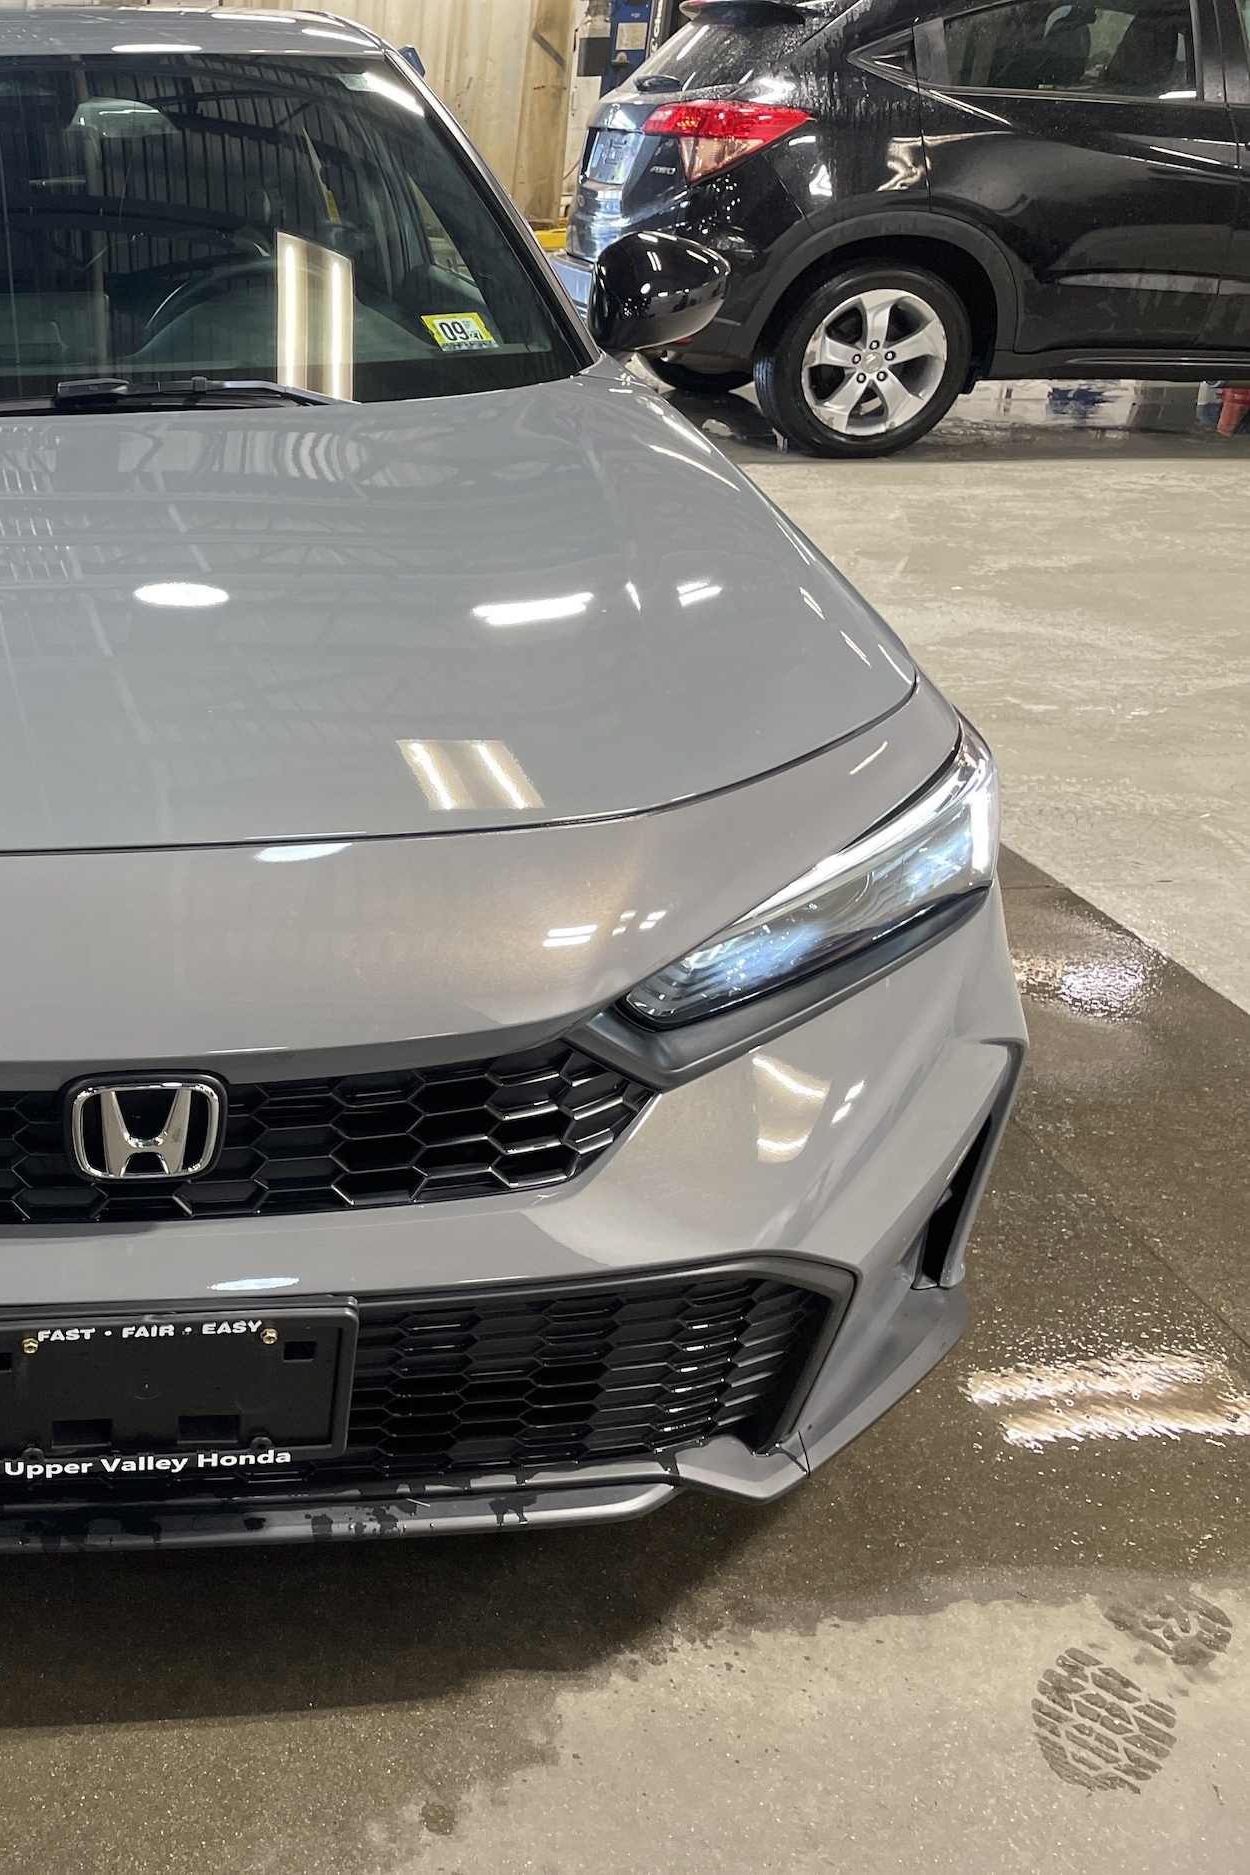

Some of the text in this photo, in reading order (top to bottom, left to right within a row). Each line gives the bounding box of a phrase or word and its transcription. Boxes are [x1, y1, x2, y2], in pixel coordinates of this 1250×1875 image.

[438, 321, 470, 341] 09
[37, 1320, 263, 1342] FAST FAIR EASY
[4, 1450, 292, 1479] Upper Valley Honda
